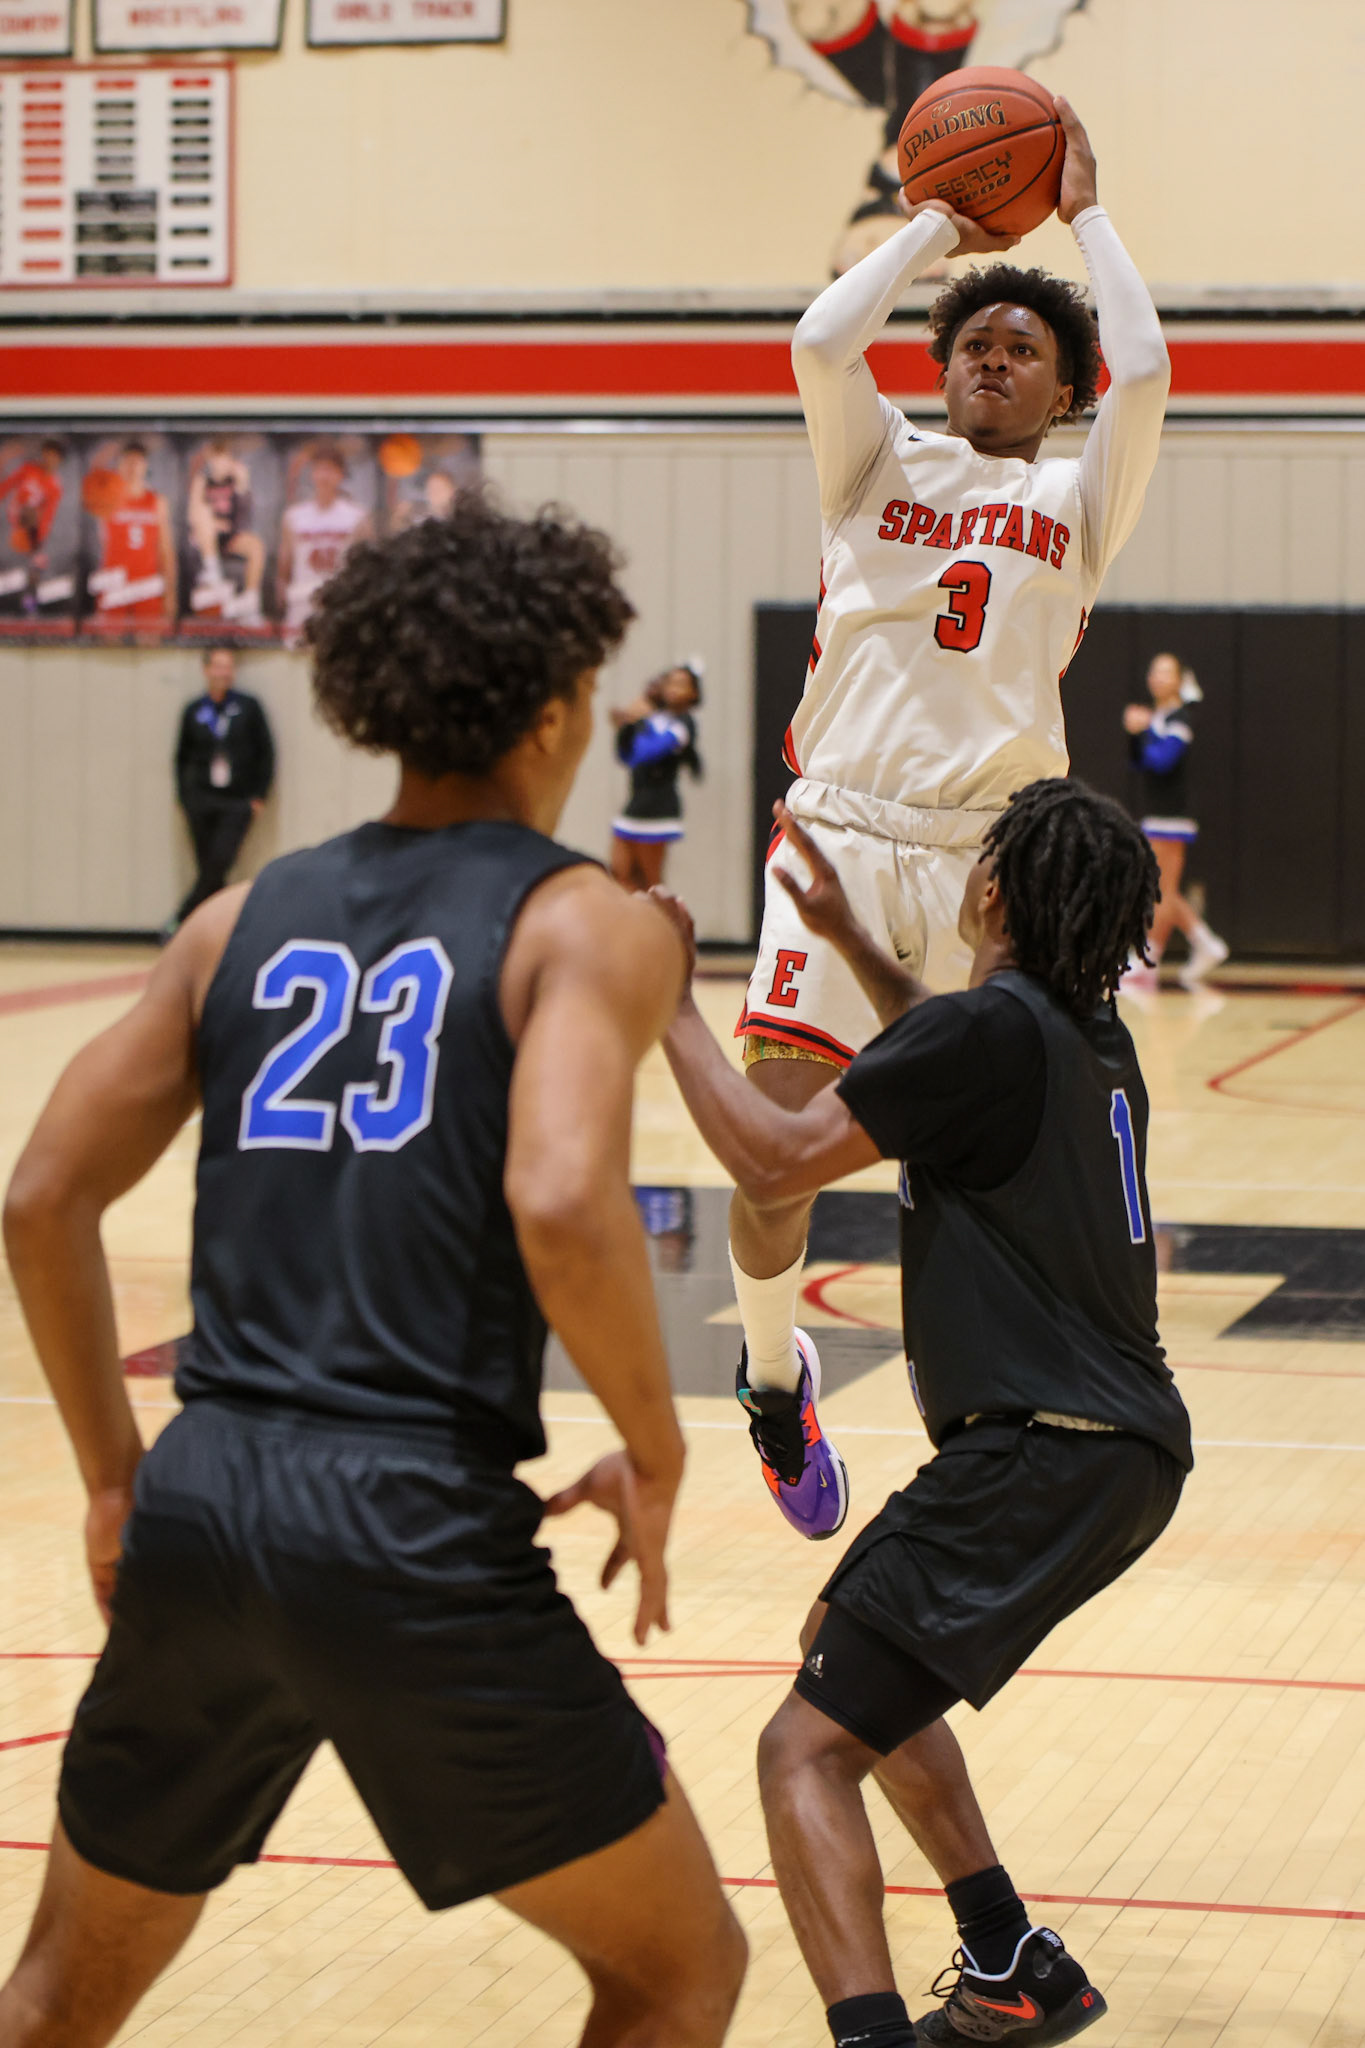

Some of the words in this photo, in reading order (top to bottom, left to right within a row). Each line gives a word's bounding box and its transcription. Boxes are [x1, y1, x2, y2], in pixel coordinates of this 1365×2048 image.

[903, 101, 1006, 167] SPALDING
[922, 151, 1013, 199] LEGACY
[878, 499, 1070, 570] SPARTANS
[934, 560, 992, 654] 3
[766, 948, 808, 1008] E
[237, 936, 455, 1153] 23
[1110, 1088, 1146, 1244] 1
